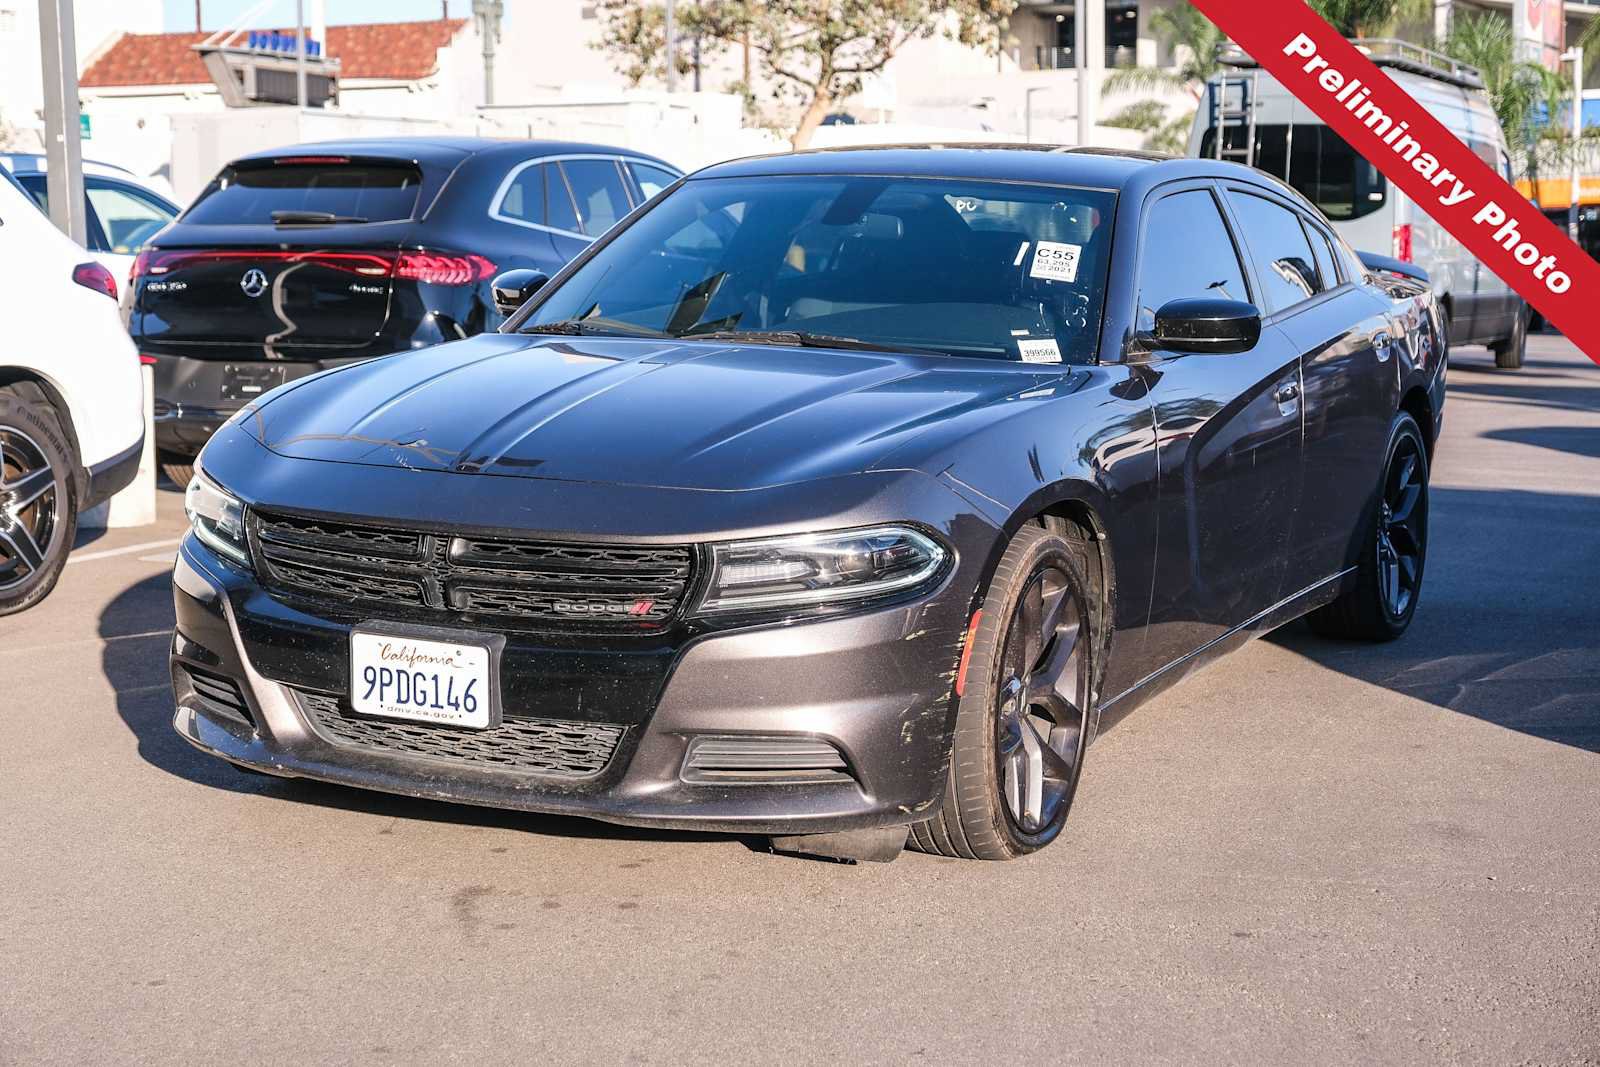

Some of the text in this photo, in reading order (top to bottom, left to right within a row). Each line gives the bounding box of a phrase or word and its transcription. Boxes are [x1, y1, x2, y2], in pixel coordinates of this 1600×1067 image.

[381, 643, 465, 668] California
[362, 665, 478, 713] 9PDG146
[387, 705, 455, 719] dmv.ca.gov
